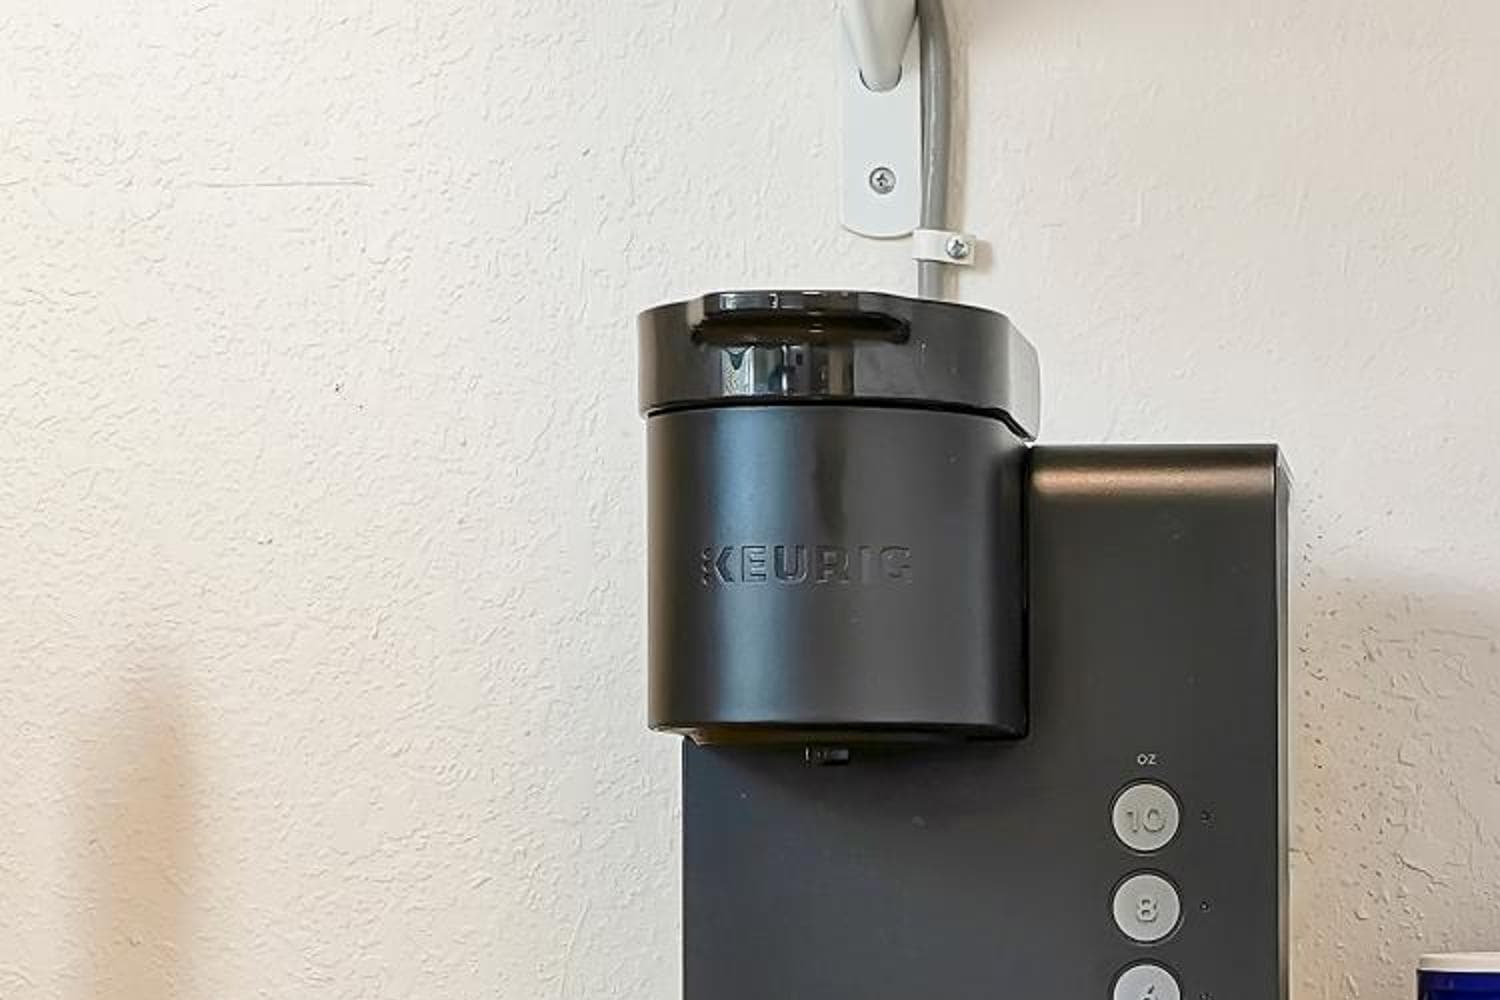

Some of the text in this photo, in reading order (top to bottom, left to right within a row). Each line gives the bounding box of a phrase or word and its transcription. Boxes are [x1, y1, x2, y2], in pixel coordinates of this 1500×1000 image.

[702, 545, 912, 583] KEURIG
[1127, 809, 1166, 833] 10
[1136, 898, 1157, 922] 8
